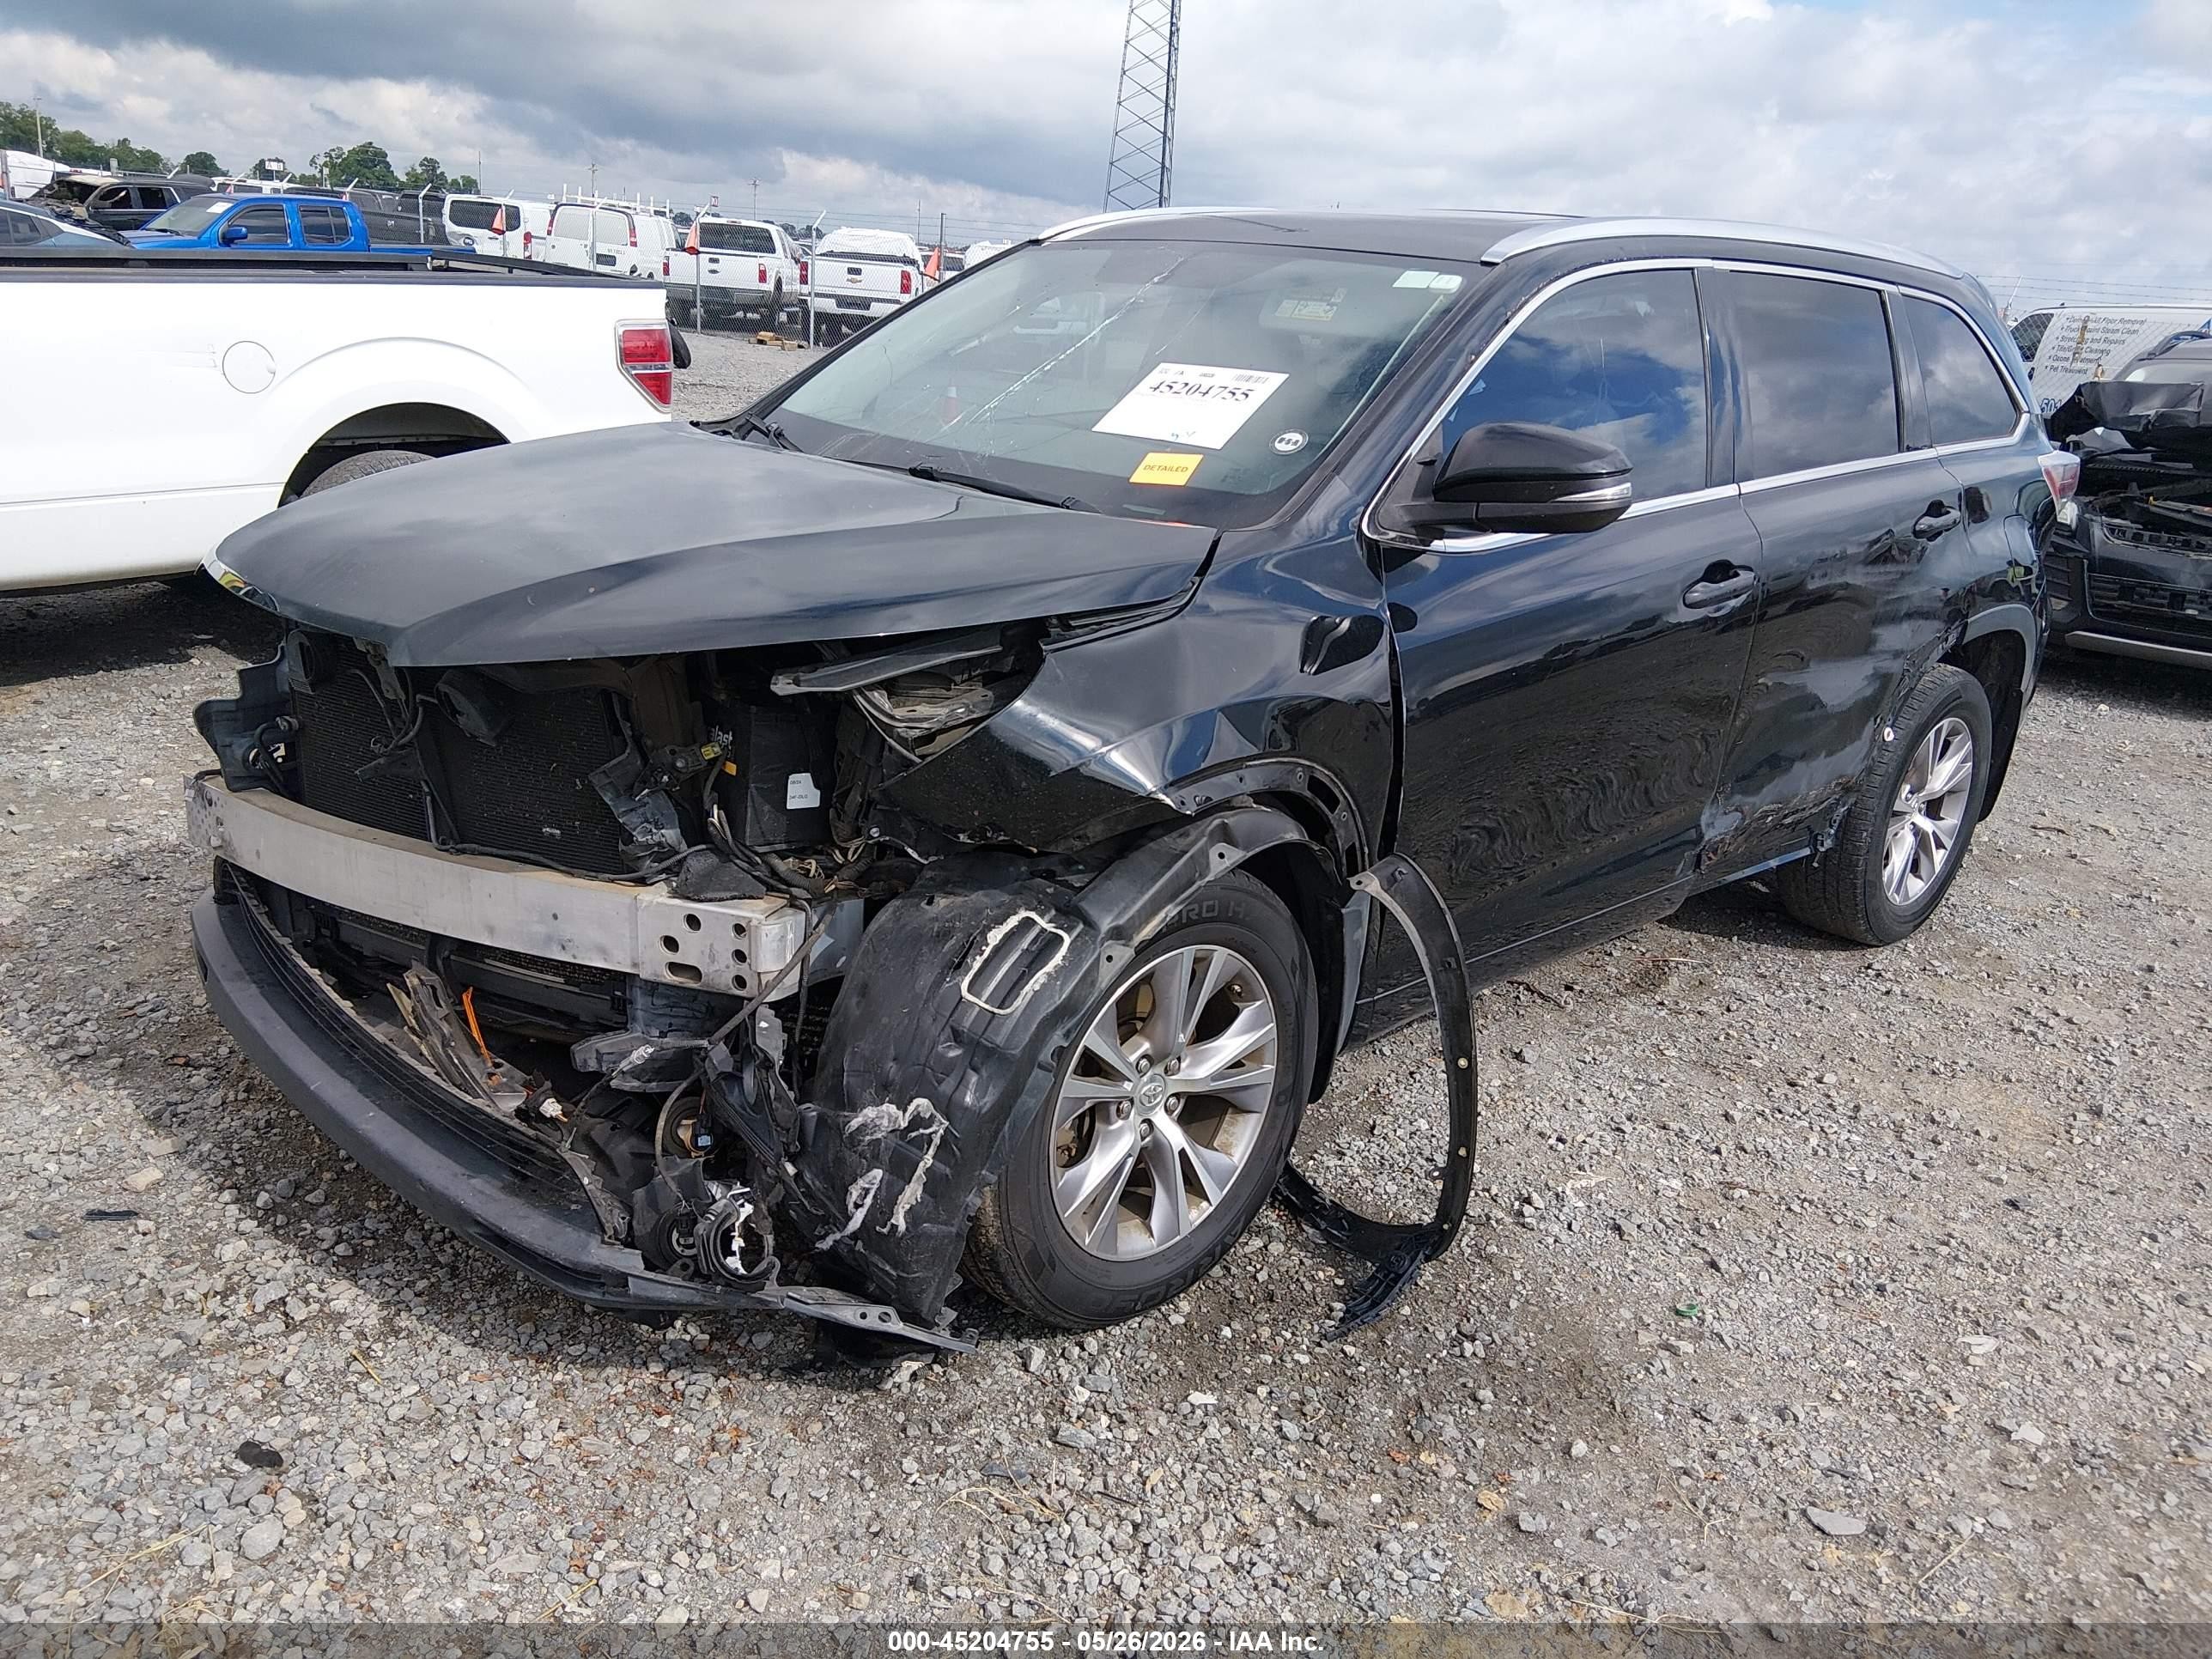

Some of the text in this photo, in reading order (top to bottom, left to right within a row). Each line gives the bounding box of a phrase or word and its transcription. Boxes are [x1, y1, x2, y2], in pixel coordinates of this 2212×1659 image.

[2059, 335, 2088, 345] Stretcg
[2102, 337, 2126, 345] Repairs
[2084, 346, 2111, 356] Cleaning
[2049, 364, 2059, 373] Pet
[1149, 380, 1255, 402] 45204755
[1143, 464, 1188, 473] DETAILED
